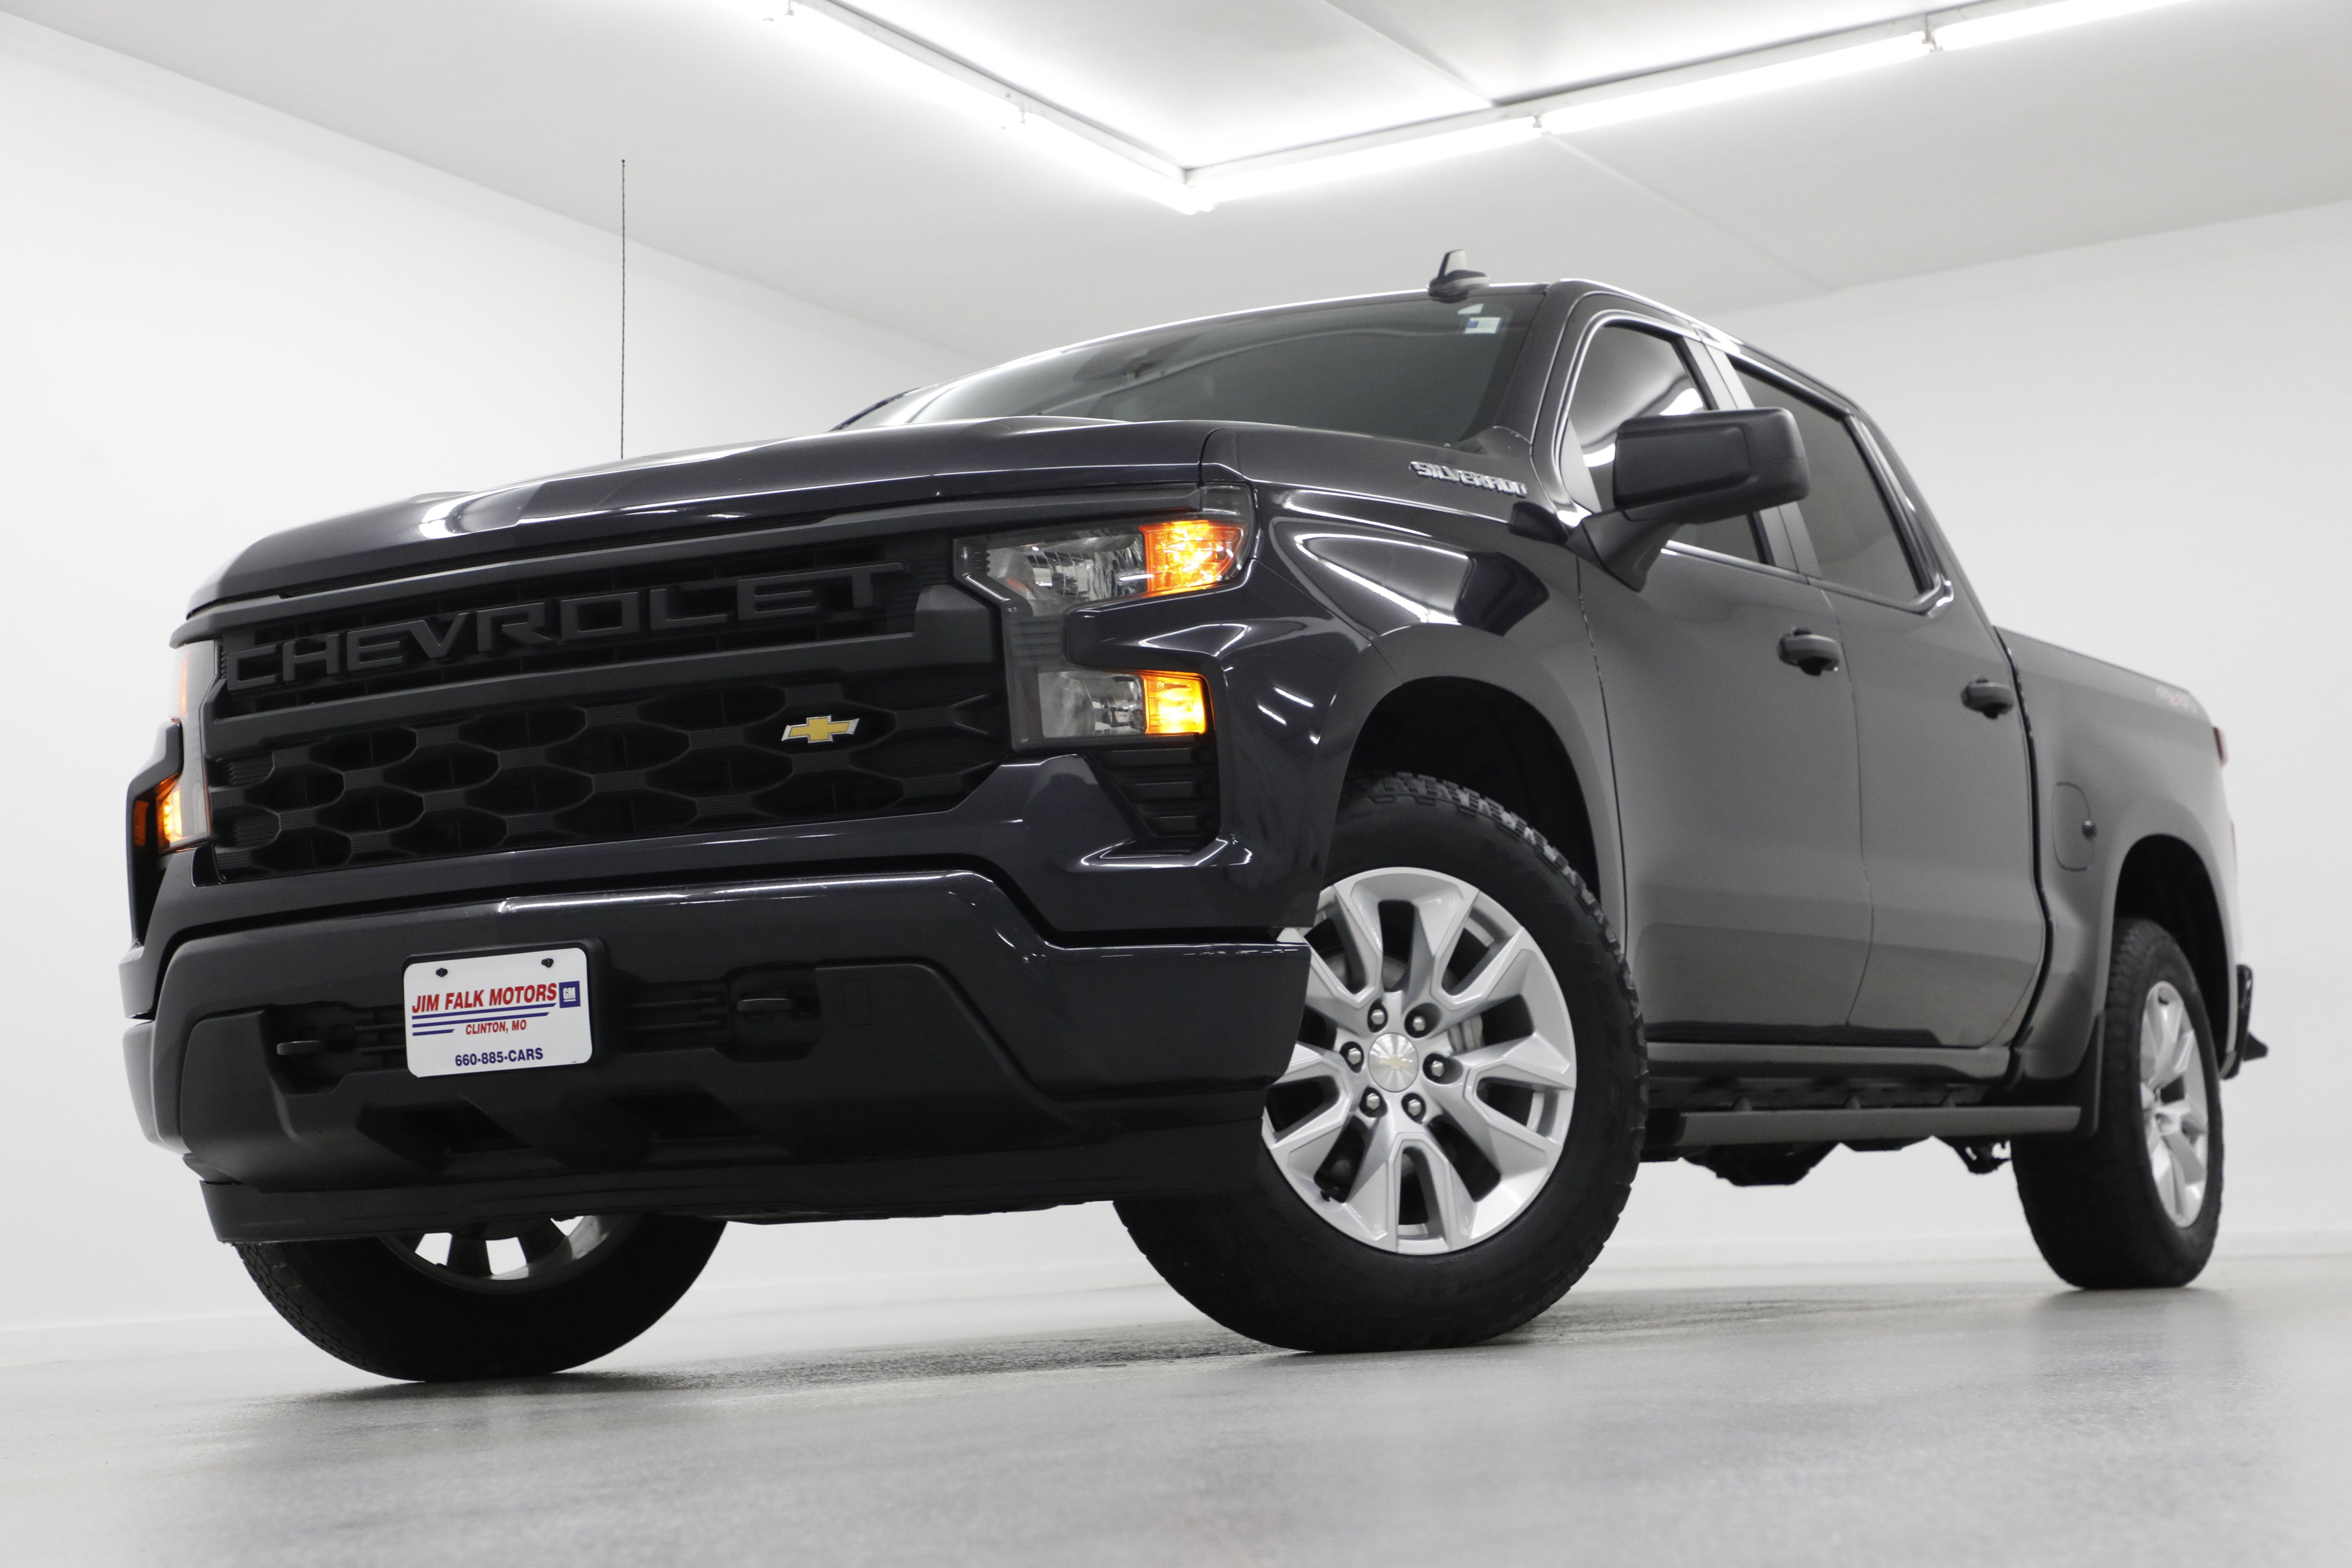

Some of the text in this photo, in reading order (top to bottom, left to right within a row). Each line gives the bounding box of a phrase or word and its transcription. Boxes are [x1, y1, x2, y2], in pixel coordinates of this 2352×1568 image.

[1410, 461, 1528, 497] SILVERADO
[227, 561, 905, 692] CHEVROLET
[412, 983, 557, 1013] JIM FALK MOTORS
[563, 987, 576, 1000] GM
[466, 1019, 527, 1035] CLINTON, MO
[454, 1047, 543, 1067] 660-885-CARS
